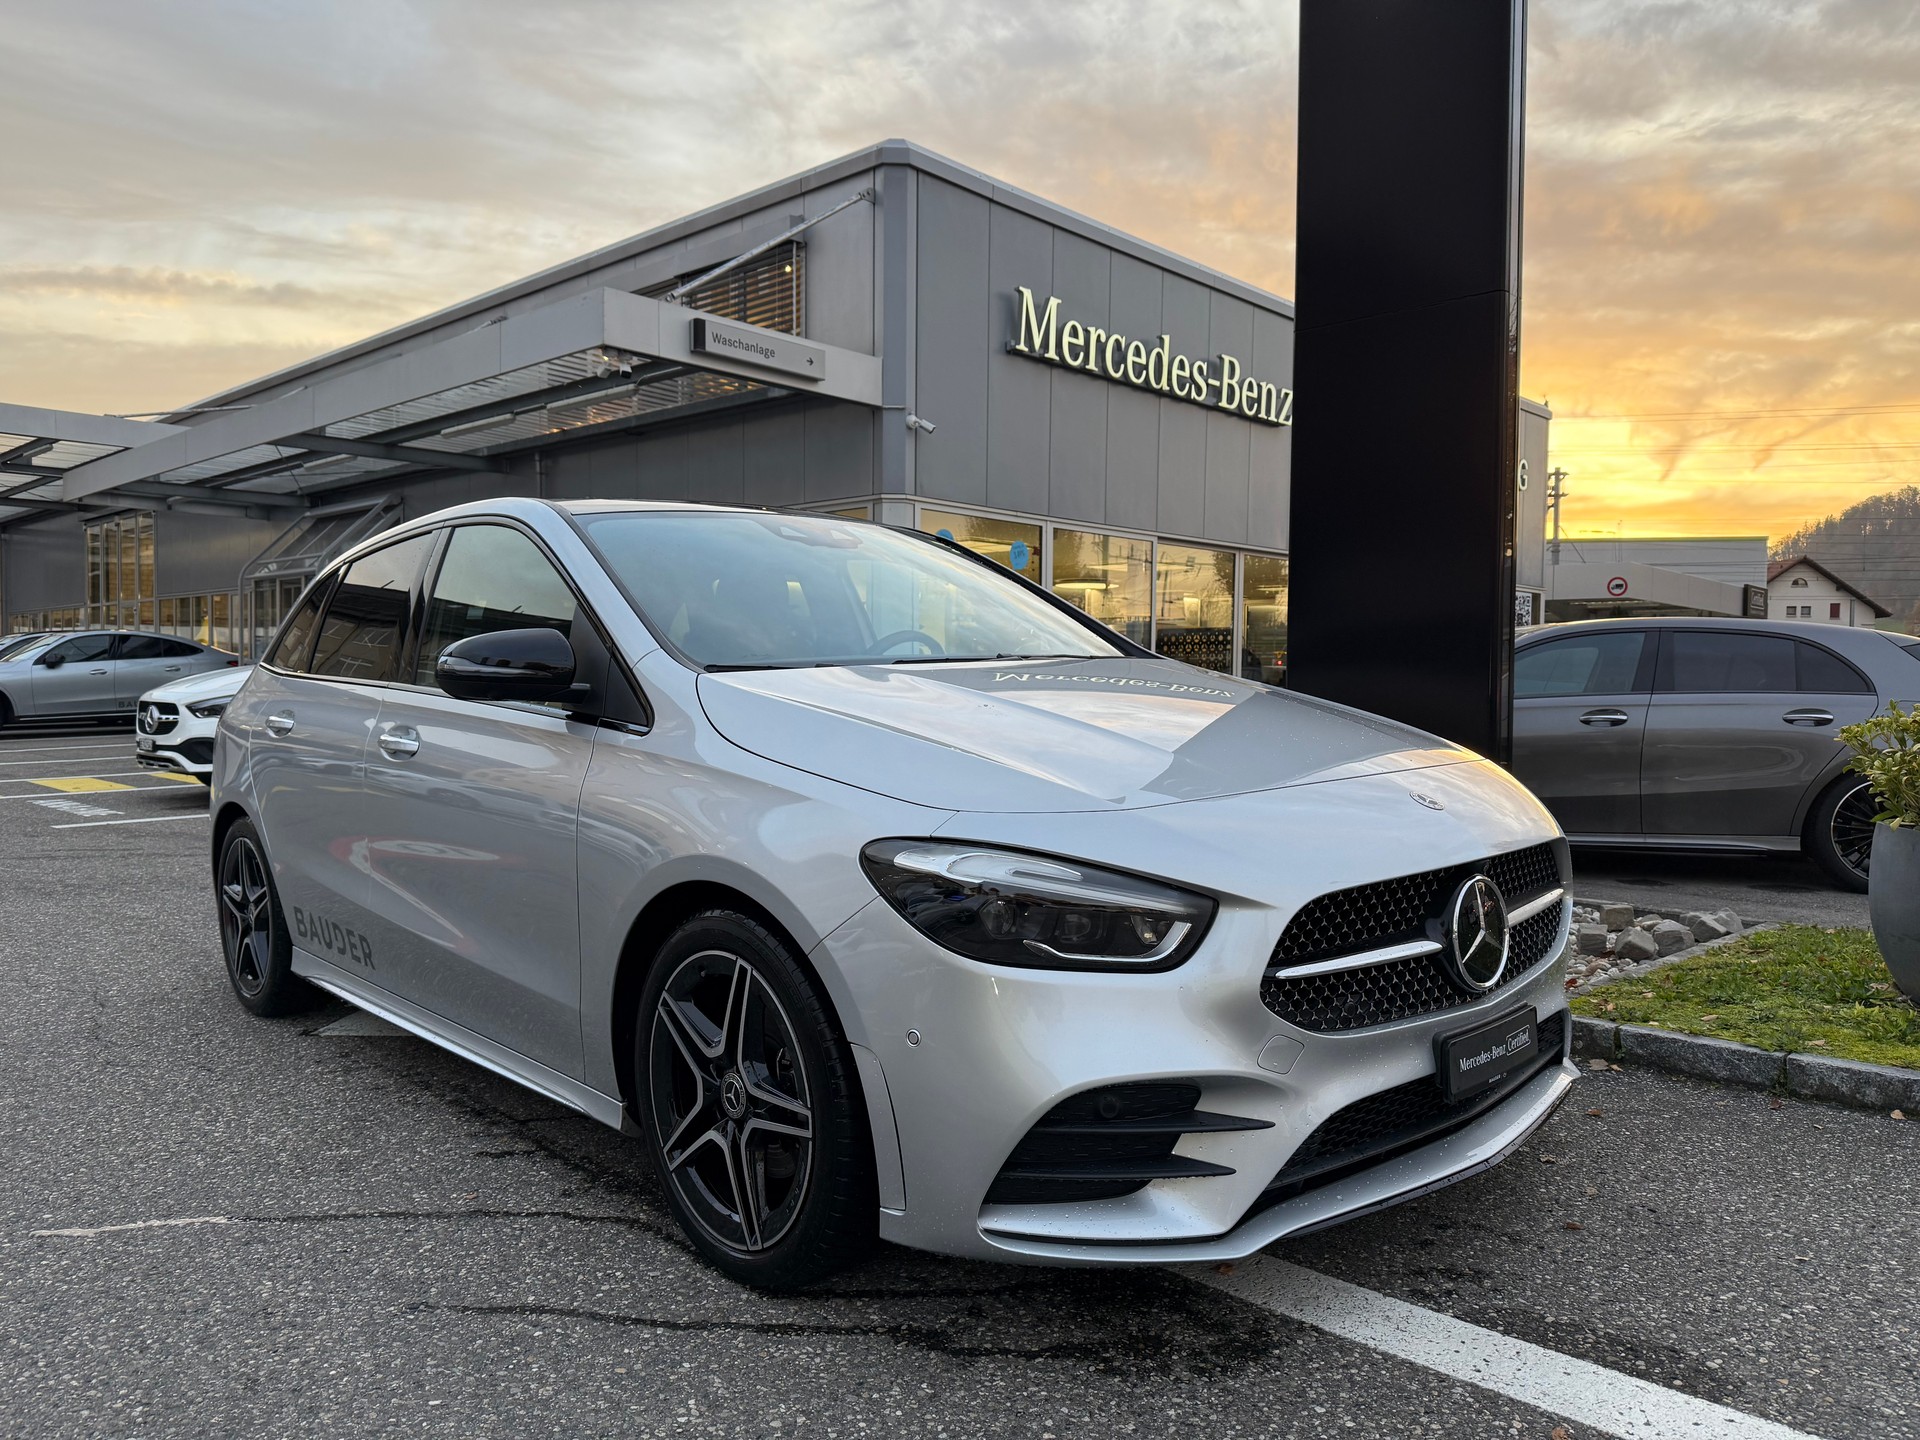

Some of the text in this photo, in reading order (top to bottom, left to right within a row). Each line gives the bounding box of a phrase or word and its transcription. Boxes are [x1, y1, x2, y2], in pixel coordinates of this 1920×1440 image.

[711, 331, 776, 359] Waschanlage
[1014, 285, 1293, 426] Mercedes-Benz
[293, 905, 377, 971] BAUDER
[1459, 1029, 1530, 1072] Mercedes-Benz Certified
